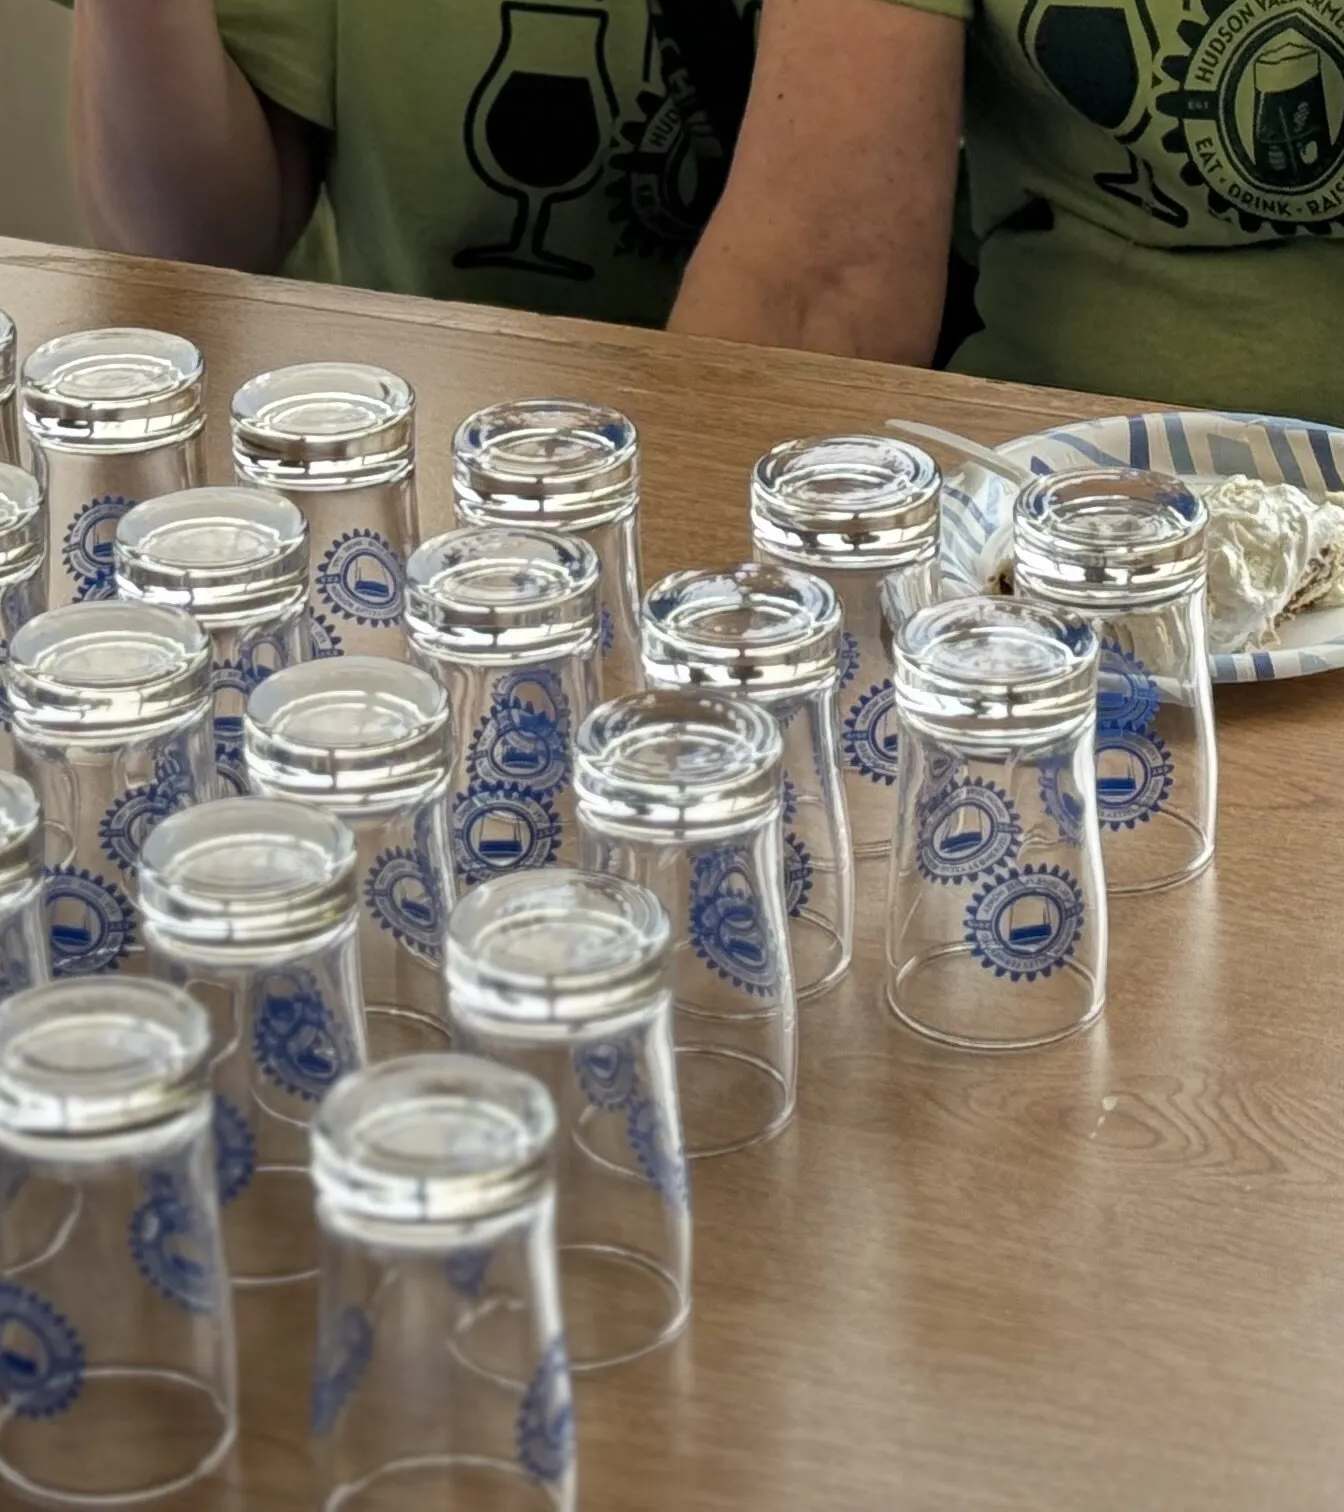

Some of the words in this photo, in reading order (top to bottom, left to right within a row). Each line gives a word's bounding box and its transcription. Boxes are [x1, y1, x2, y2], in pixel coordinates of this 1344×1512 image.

[1195, 5, 1254, 84] HUDSON
[649, 106, 682, 148] HUD
[1195, 136, 1223, 176] EAT
[1227, 183, 1293, 218] DRINK
